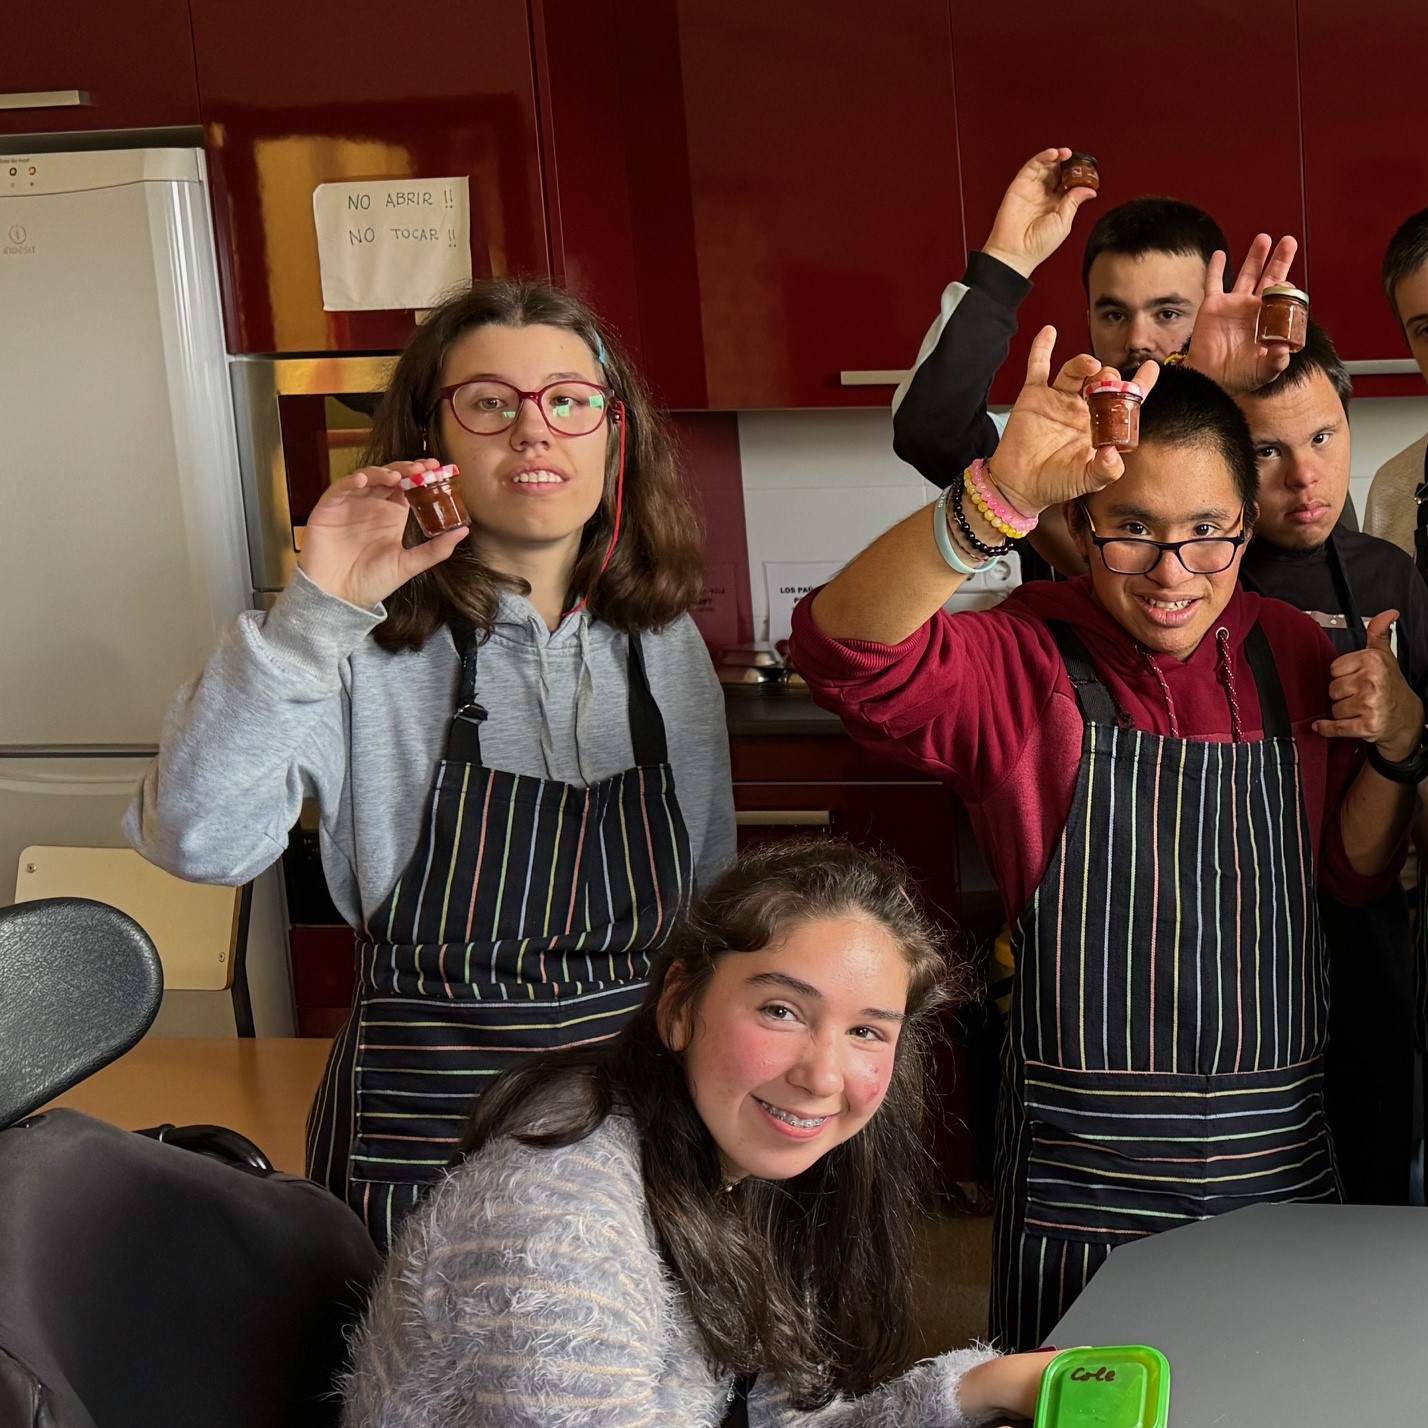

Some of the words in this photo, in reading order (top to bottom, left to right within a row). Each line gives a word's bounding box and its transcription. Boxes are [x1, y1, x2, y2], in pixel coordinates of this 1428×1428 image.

[348, 194, 371, 210] NO
[385, 192, 433, 208] ABRIR
[444, 189, 453, 209] !!
[349, 227, 375, 246] NO
[390, 228, 439, 241] TOCAR
[447, 229, 457, 248] !!
[1071, 1366, 1116, 1382] Cole
